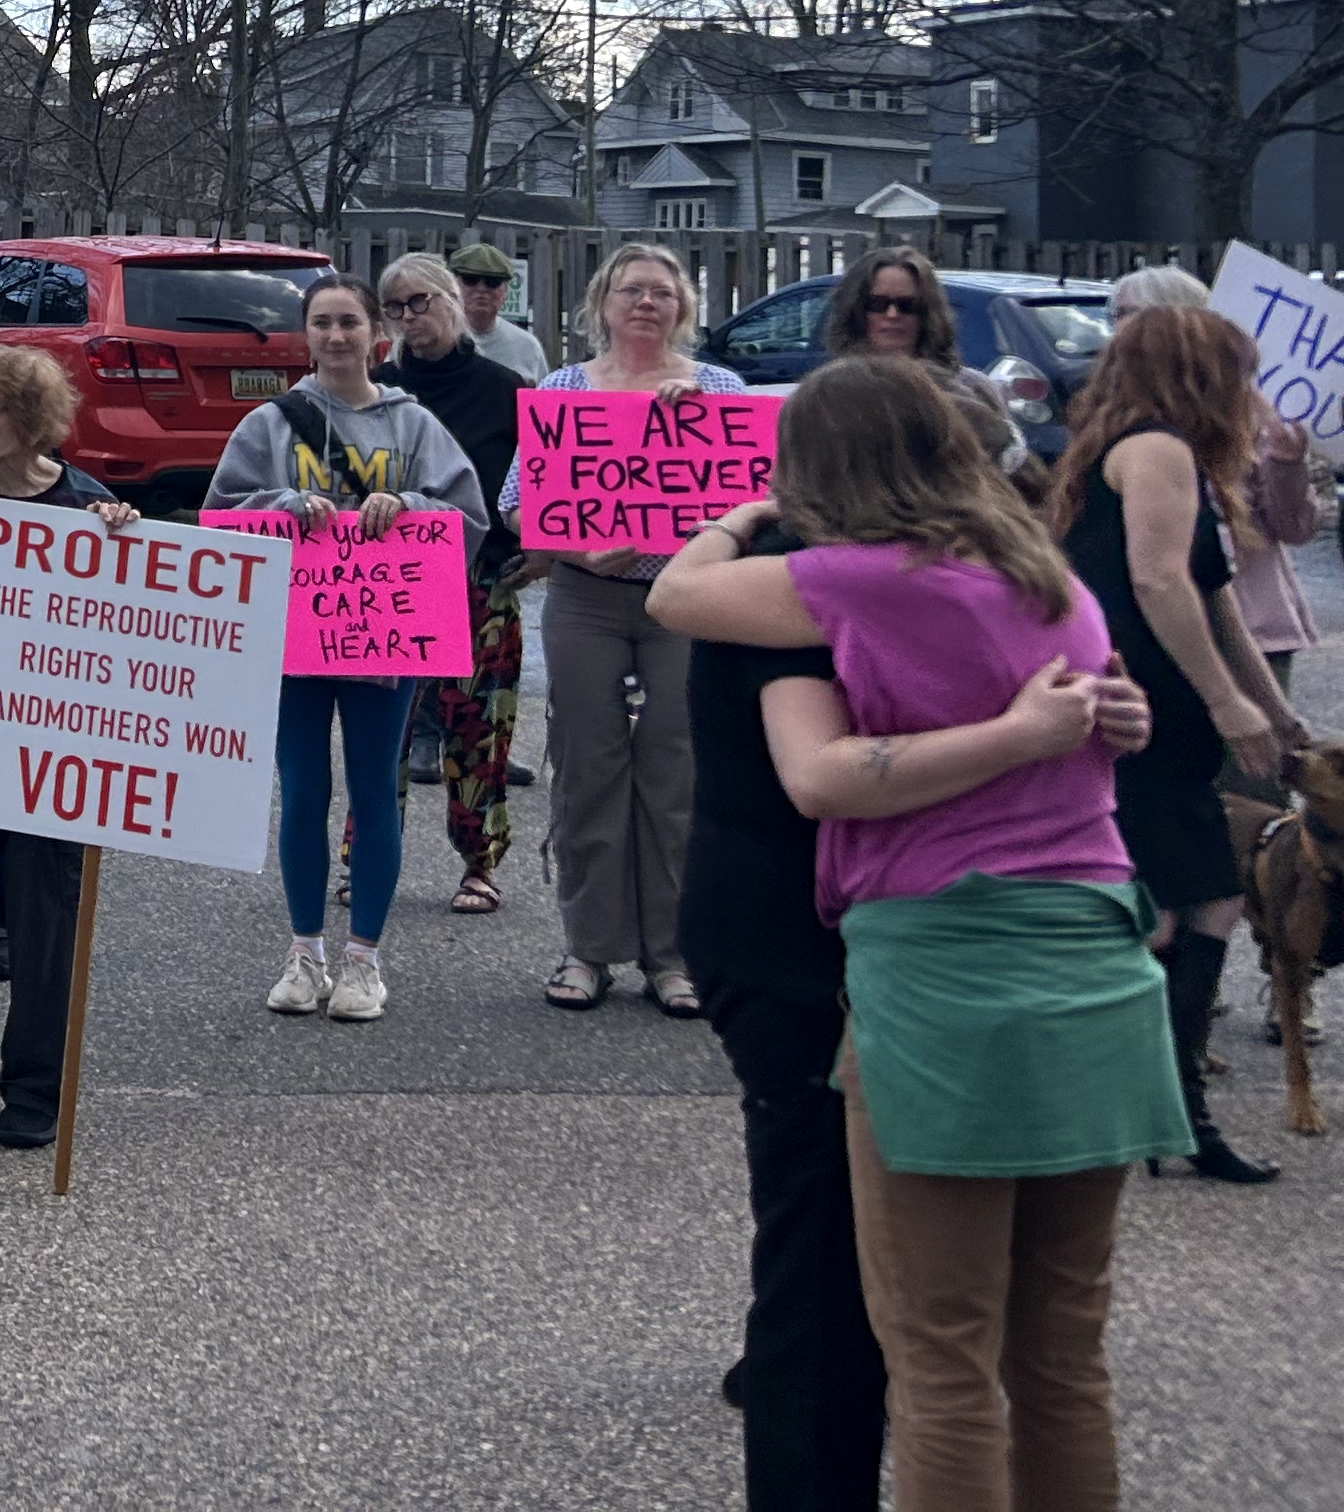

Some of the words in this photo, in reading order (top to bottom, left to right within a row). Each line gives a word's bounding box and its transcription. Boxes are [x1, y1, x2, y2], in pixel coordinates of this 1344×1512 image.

[529, 403, 613, 450] WE
[641, 399, 757, 448] ARE
[570, 455, 772, 494] FOREVER
[396, 520, 452, 545] FOR
[312, 586, 416, 618] CARE
[47, 593, 245, 653] REPRODUCTIVE
[345, 618, 369, 633] and
[319, 629, 437, 664] HEART
[19, 641, 113, 685] RIGHTS
[127, 658, 196, 700] YOUR
[184, 722, 253, 764] WON.
[18, 746, 179, 839] VOTE!
